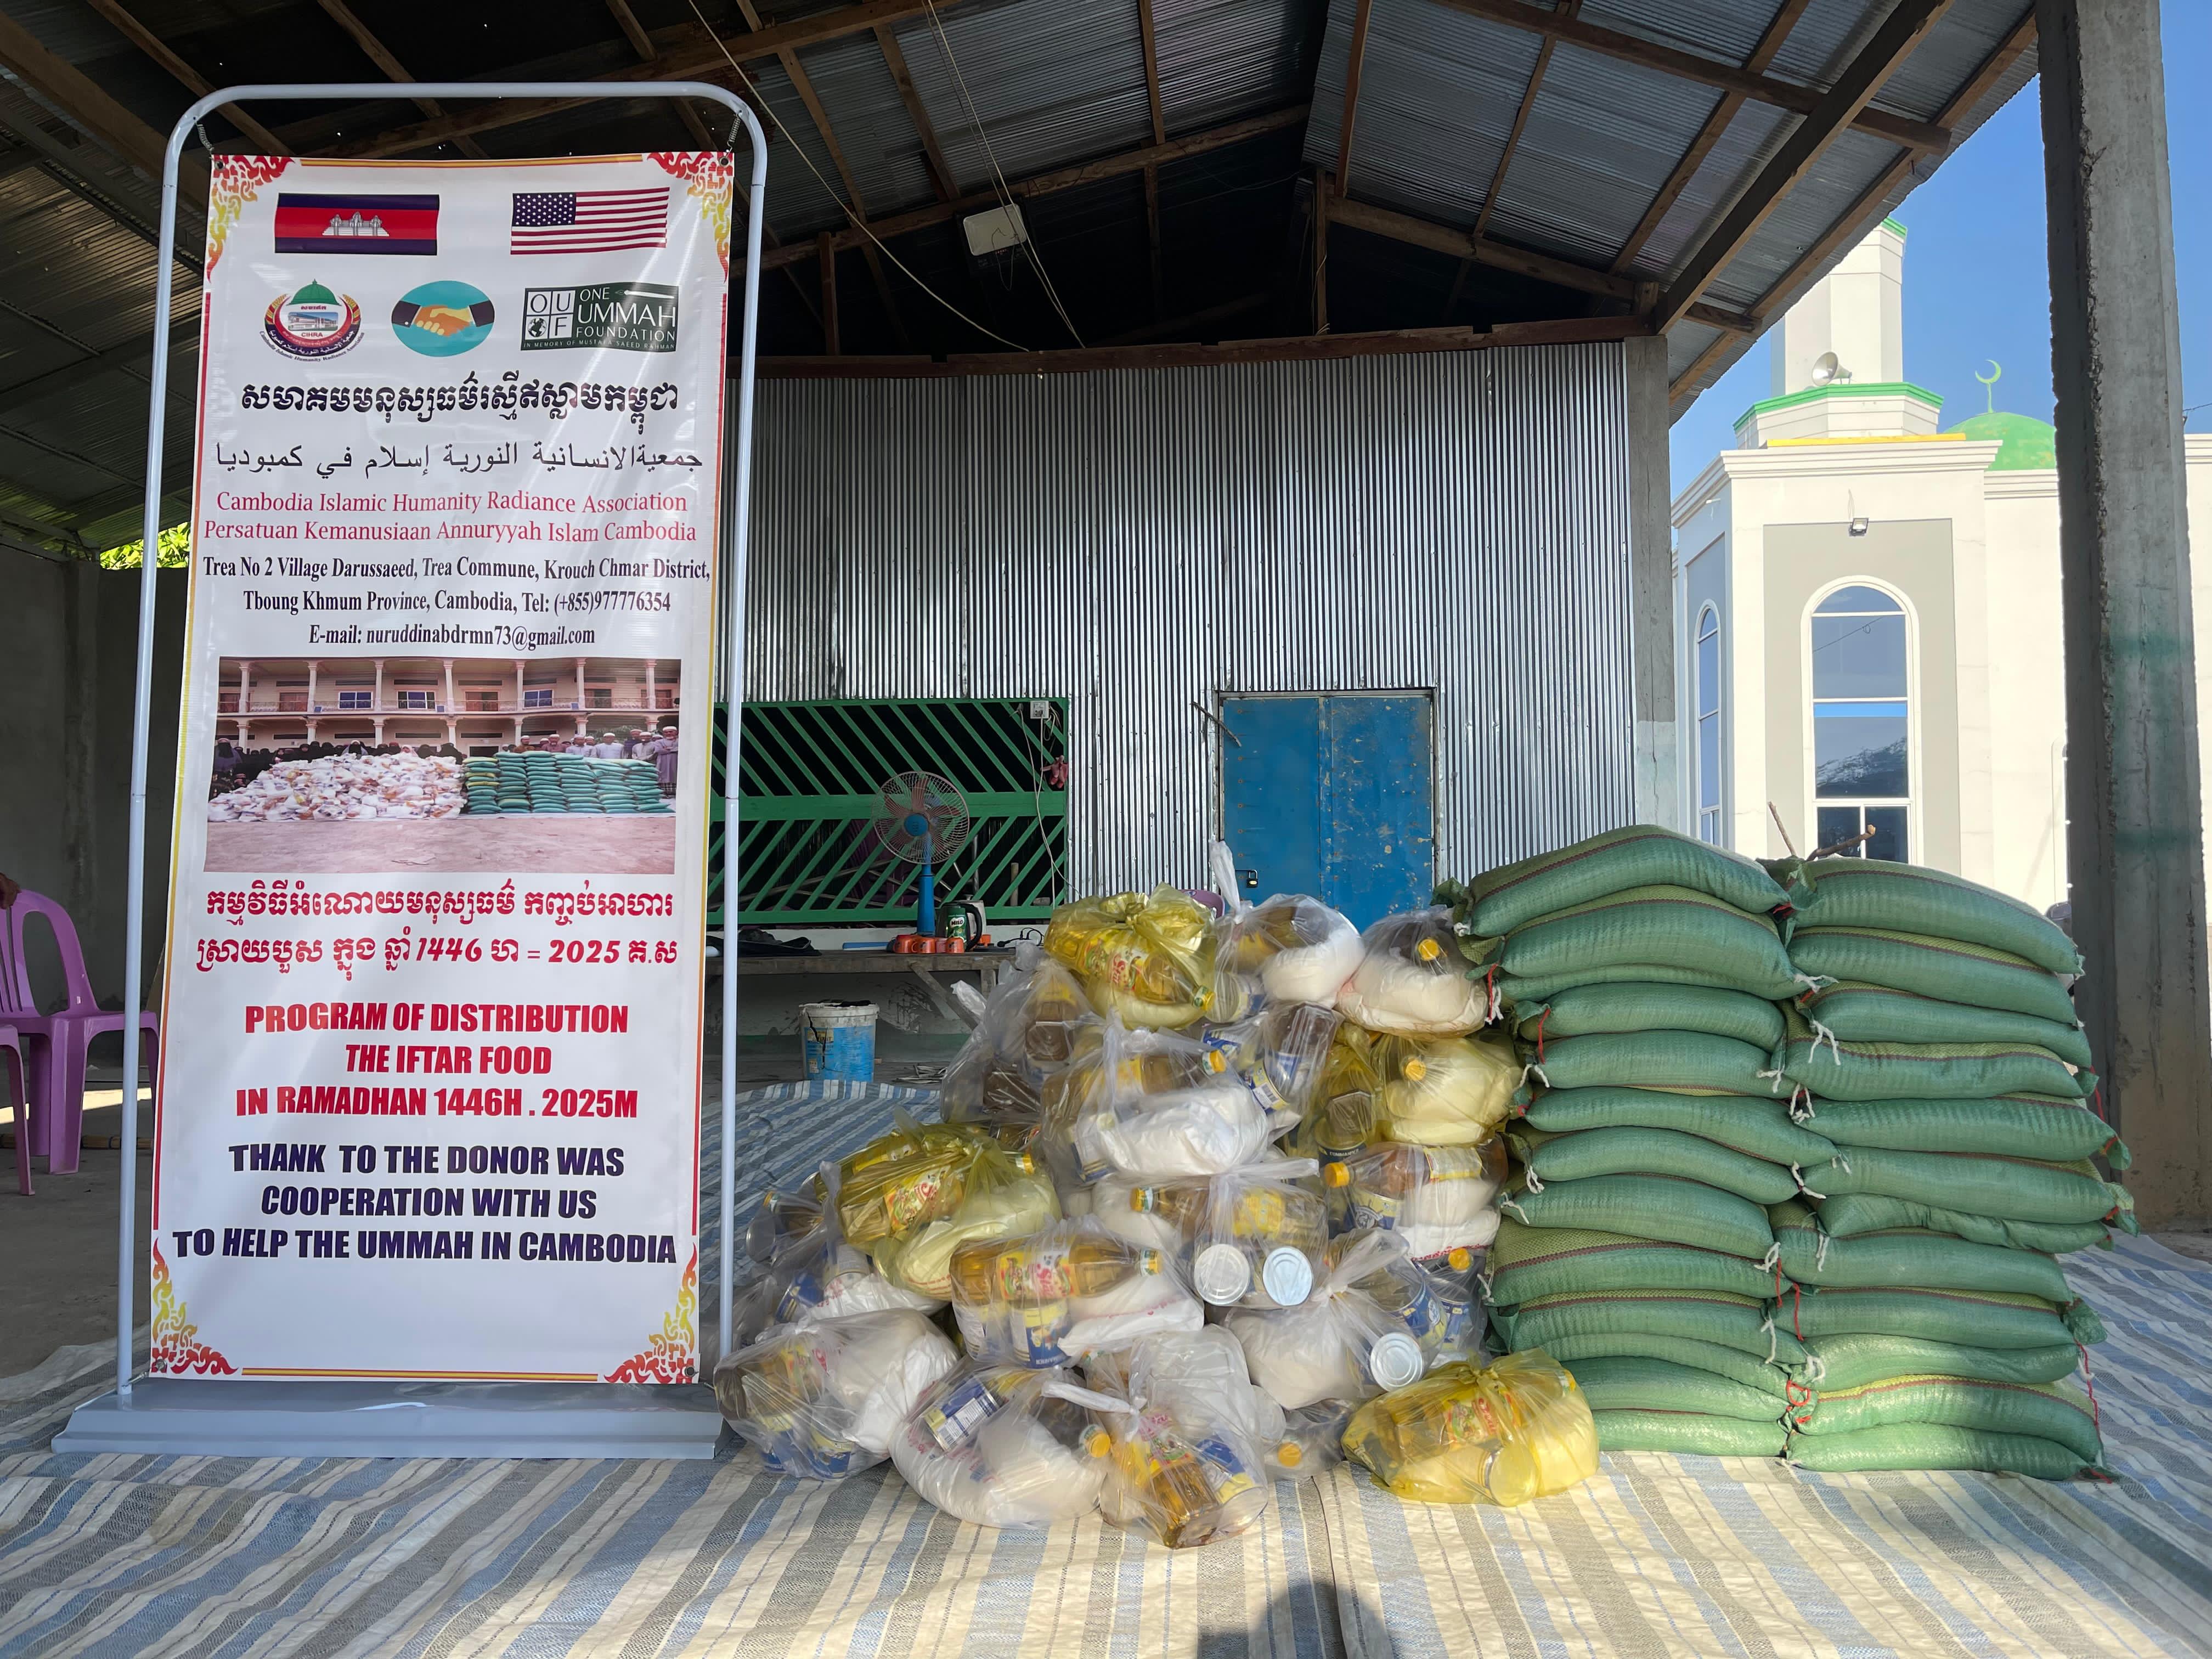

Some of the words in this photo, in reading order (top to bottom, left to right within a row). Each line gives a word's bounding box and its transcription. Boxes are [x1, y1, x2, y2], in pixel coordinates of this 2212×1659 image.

[579, 287, 611, 302] ONE
[578, 302, 676, 328] UMMAH
[576, 326, 675, 342] FOUNDATION
[216, 442, 303, 473] كمبوديا
[316, 446, 352, 479] في
[365, 444, 429, 479] إسلام
[443, 441, 517, 473] النورية
[217, 491, 313, 511] Cambodia
[318, 492, 387, 512] Islamic
[392, 492, 482, 514] Humanity
[487, 489, 575, 513] Radiance
[582, 492, 688, 514] Association
[204, 520, 298, 539] Persatuan
[304, 521, 431, 540] Kemanusiaan
[436, 520, 543, 544] Annuryyah
[548, 522, 599, 542] Islam
[604, 520, 697, 541] Cambodia
[202, 556, 236, 577] Trea
[239, 556, 261, 577] No
[263, 556, 273, 576] 2
[276, 557, 328, 583] Village
[331, 557, 417, 581] Darussaeed,
[422, 557, 453, 577] Trea
[456, 556, 539, 583] Commune,
[544, 559, 595, 579] Krouch
[599, 557, 649, 577] Chmar
[653, 558, 710, 583] District,
[243, 590, 299, 616] Tboung
[302, 590, 362, 611] Khmum
[366, 590, 431, 613] Province,
[435, 589, 517, 616] Cambodia,
[521, 592, 549, 613] Tel:
[554, 590, 671, 617] (+855)977776354
[308, 624, 362, 644] E-mail:
[366, 623, 595, 651] nuruddinabdrmn73@gmail.com
[333, 937, 376, 981] ក្នុង
[415, 937, 482, 962] 1446
[548, 939, 621, 964] 2025
[245, 1002, 388, 1034] PROGRAM
[392, 1002, 425, 1031] OF
[430, 1003, 628, 1034] DISTRIBUTION
[345, 1044, 391, 1073] THE
[396, 1045, 472, 1074] IFTAR
[479, 1045, 552, 1075] FOOD
[236, 1087, 268, 1116] IN
[276, 1085, 427, 1116] RAMADHAN
[433, 1088, 522, 1116] 1446H
[541, 1088, 638, 1118] 2025M
[228, 1143, 328, 1173] THANK
[338, 1144, 377, 1174] TO
[383, 1145, 439, 1174] THE
[447, 1145, 549, 1175] DONOR
[556, 1147, 624, 1177] WAS
[261, 1185, 465, 1217] COOPERATION
[471, 1188, 551, 1218] WITH
[558, 1189, 597, 1220] US
[172, 1228, 215, 1258] TO
[222, 1227, 289, 1258] HELP
[294, 1229, 350, 1259] THE
[357, 1230, 474, 1260] UMMAH
[481, 1231, 512, 1260] IN
[518, 1231, 677, 1264] CAMBODIA
